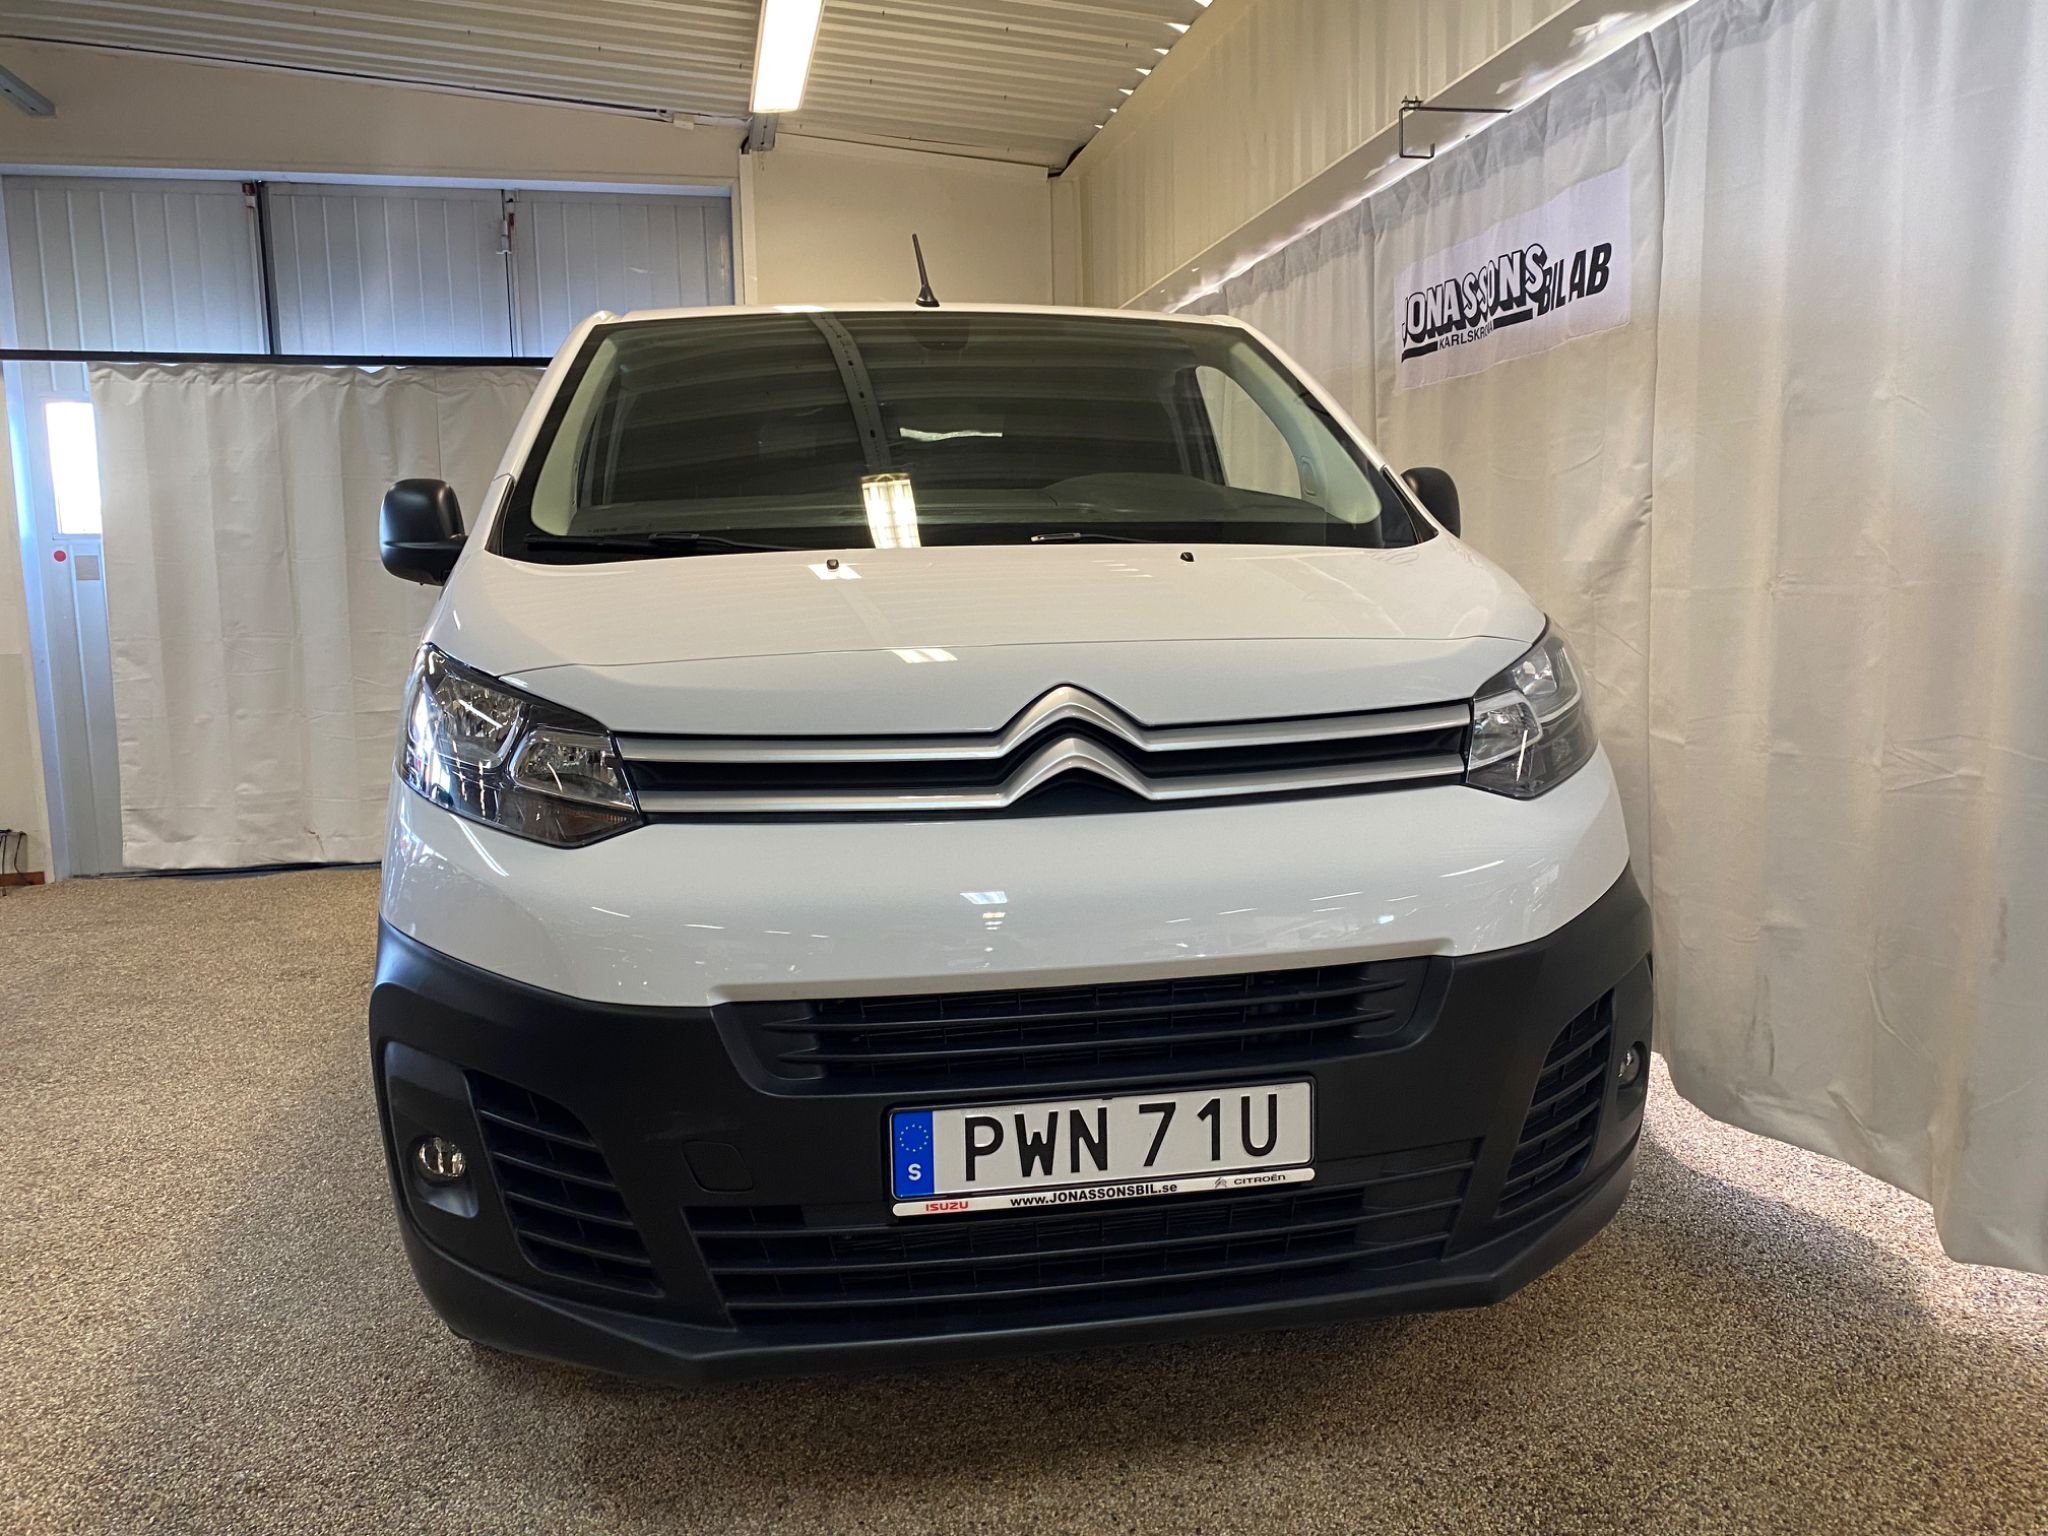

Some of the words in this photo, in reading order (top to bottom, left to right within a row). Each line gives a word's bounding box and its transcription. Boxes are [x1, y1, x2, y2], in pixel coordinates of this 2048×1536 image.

[1537, 259, 1566, 317] BIL
[1569, 243, 1612, 302] AB
[965, 1106, 1108, 1182] PWN
[1139, 1094, 1278, 1168] 71U
[908, 1163, 922, 1181] S
[925, 1201, 969, 1212] ISUZU
[1010, 1182, 1178, 1207] www.JONASSONSBIL.se
